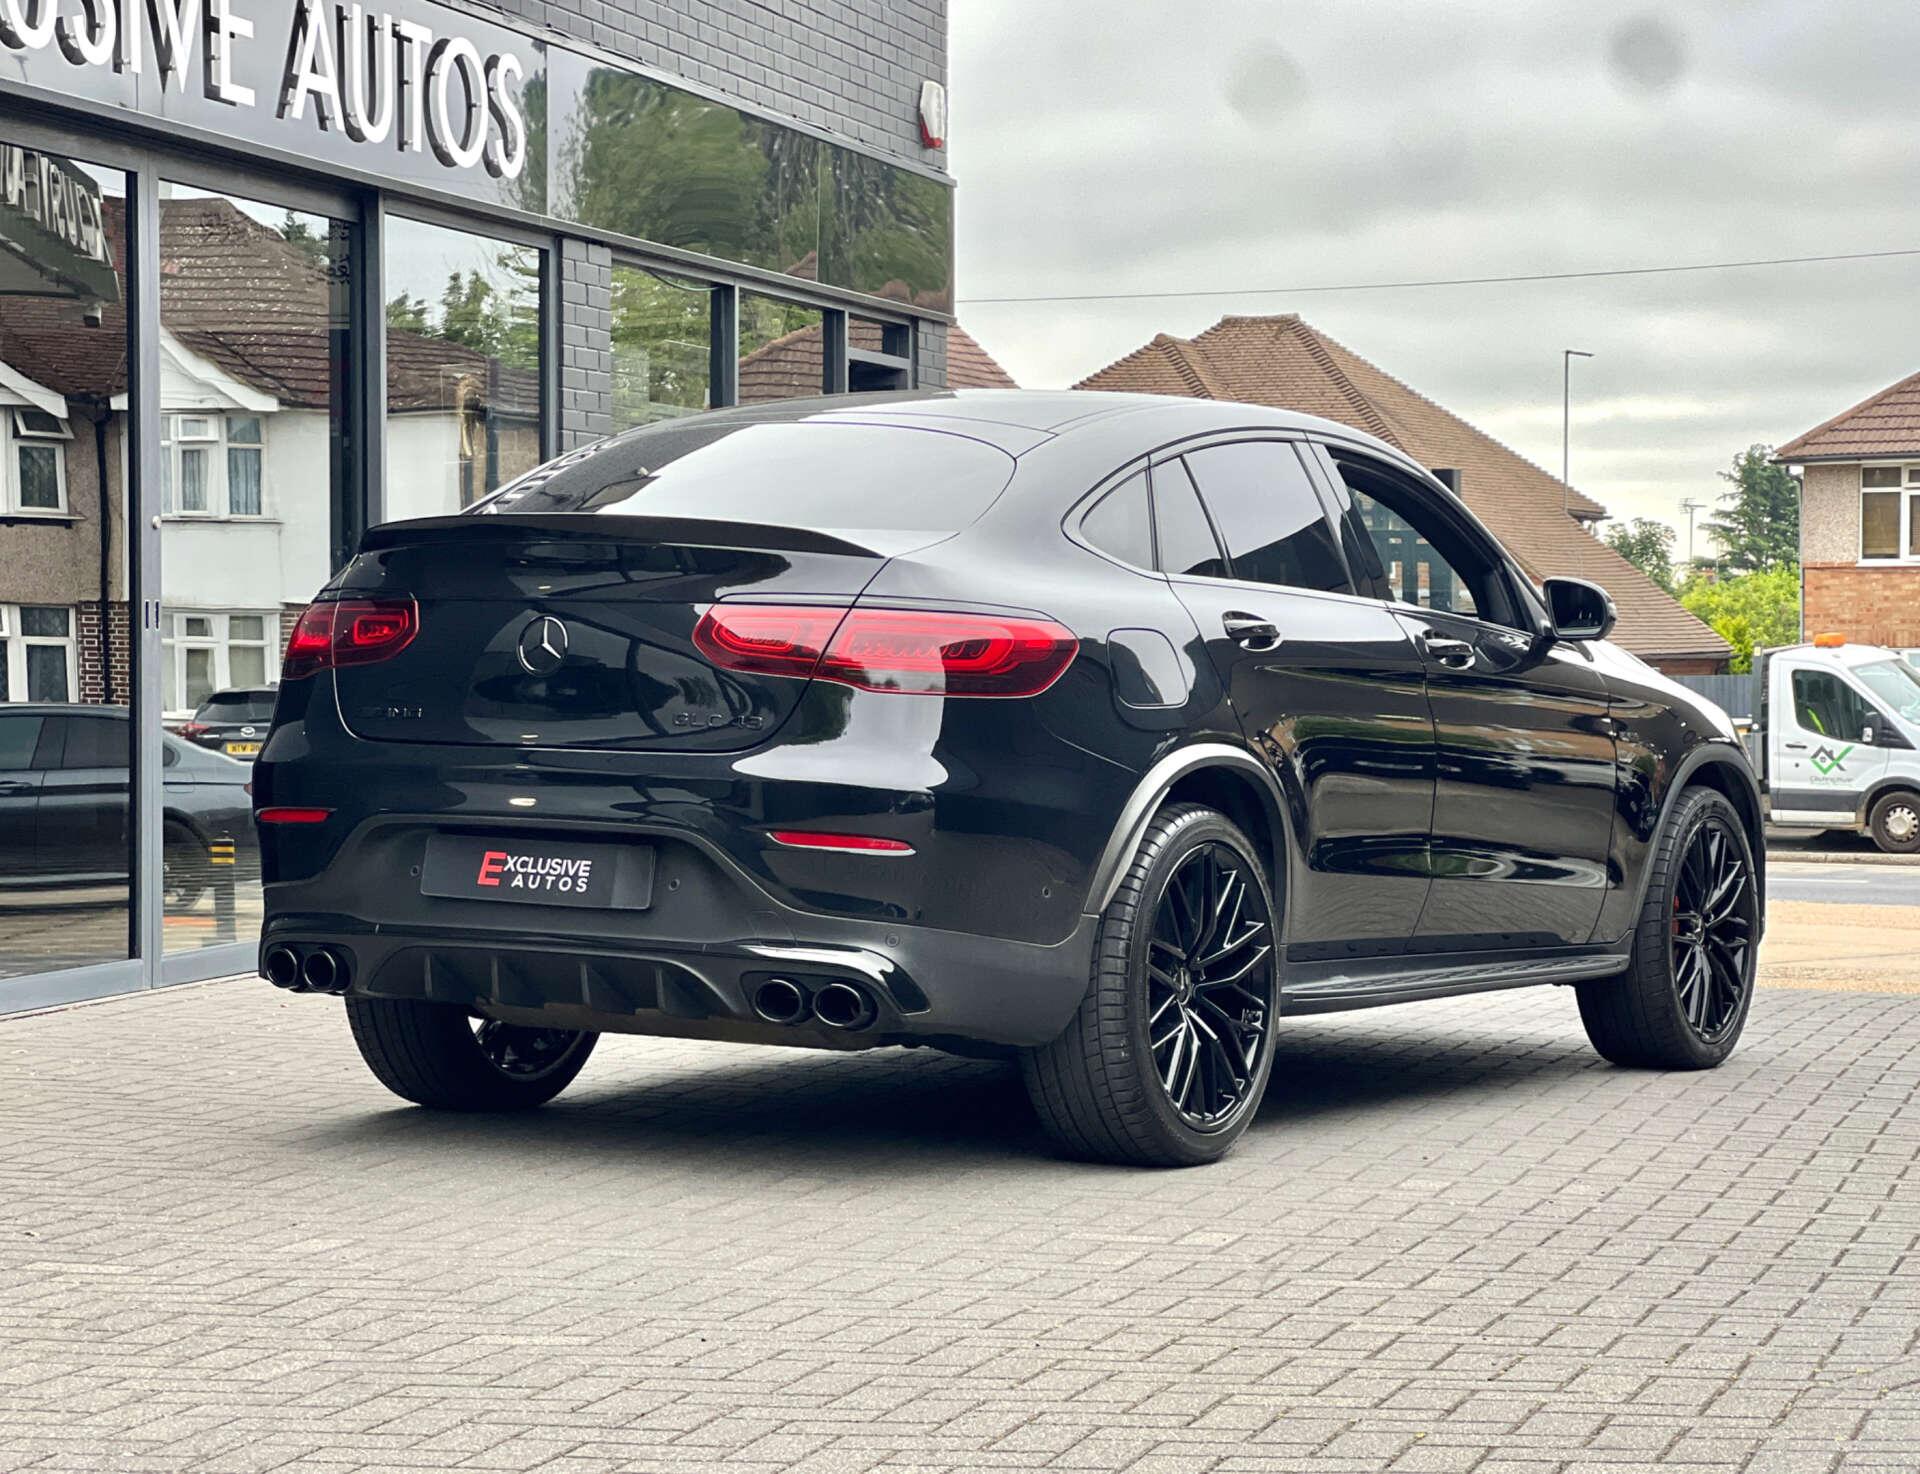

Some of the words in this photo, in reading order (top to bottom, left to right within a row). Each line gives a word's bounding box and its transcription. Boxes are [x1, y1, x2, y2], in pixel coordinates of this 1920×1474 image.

[291, 0, 526, 179] AUTOS
[477, 851, 592, 886] EXCLUSIVE
[511, 873, 588, 893] AUTOS
